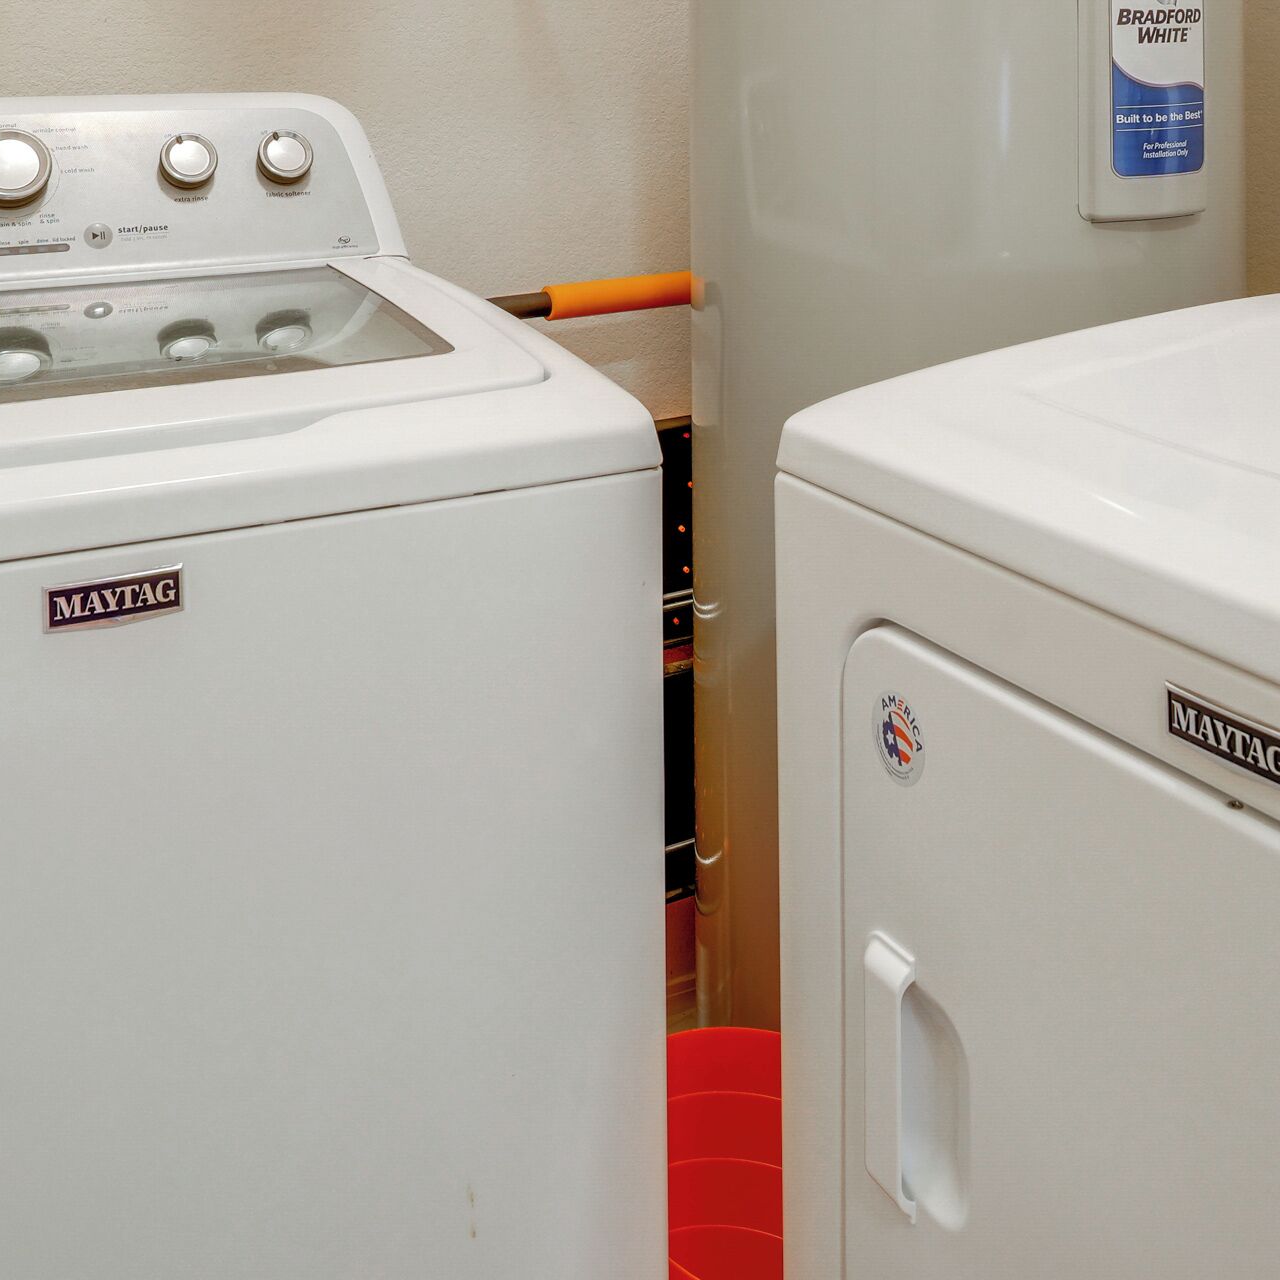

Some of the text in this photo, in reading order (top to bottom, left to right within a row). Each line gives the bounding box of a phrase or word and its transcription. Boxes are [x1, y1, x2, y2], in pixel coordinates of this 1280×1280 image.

[1117, 8, 1202, 26] BRADFORD
[1138, 27, 1189, 44] WHITE
[1116, 111, 1201, 124] Built to be the Best
[1143, 140, 1188, 151] For Professional
[1143, 149, 1189, 159] Installation Only
[118, 225, 169, 234] start/pause
[53, 579, 177, 621] MAYTAG
[881, 695, 923, 753] AMERICA
